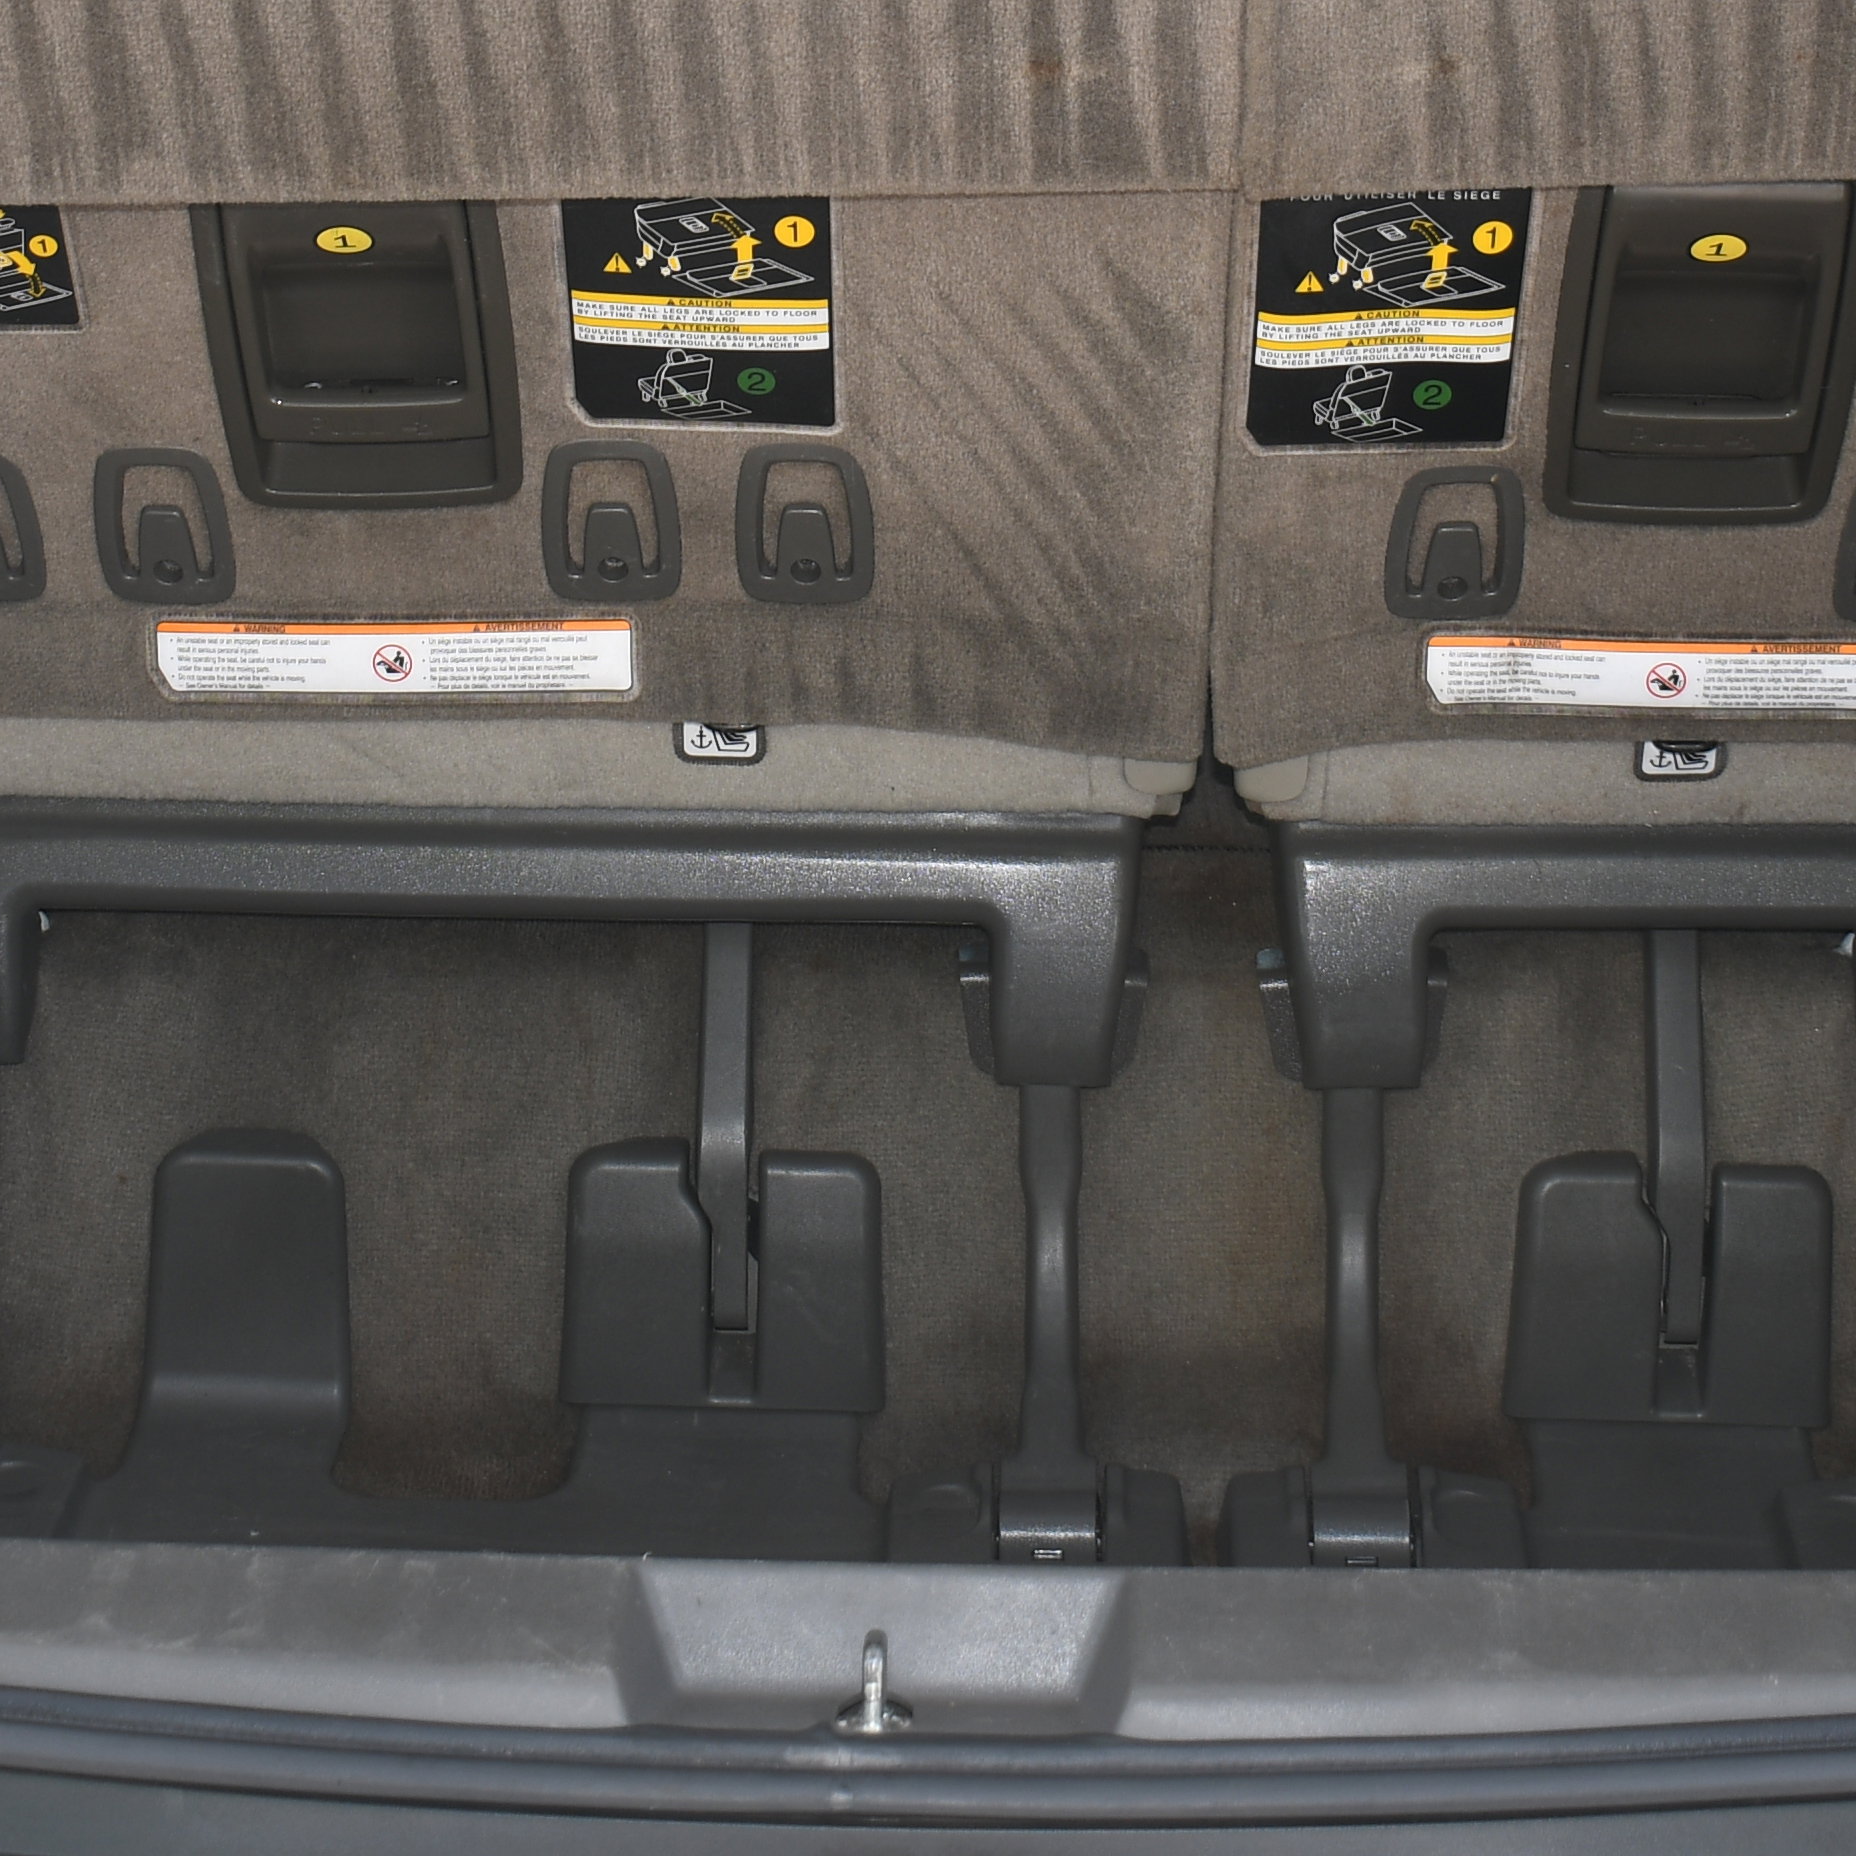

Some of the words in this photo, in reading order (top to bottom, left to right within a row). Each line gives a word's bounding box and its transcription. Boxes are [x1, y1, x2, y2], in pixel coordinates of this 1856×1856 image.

[1428, 190, 1445, 200] LE
[787, 221, 798, 243] 1
[334, 234, 356, 248] 1
[1486, 227, 1497, 249] 1
[37, 239, 47, 253] 1
[1706, 242, 1727, 257] 1
[577, 302, 605, 310] MAKE
[609, 304, 636, 312] SURE
[679, 298, 732, 308] CAUTION
[594, 310, 633, 318] LIFTING
[1367, 309, 1420, 319] CAUTION
[673, 324, 740, 333] ATTENTION
[1262, 324, 1290, 333] MAKE
[1469, 320, 1504, 328] FLOOR
[1279, 332, 1319, 340] LIFTING
[1348, 328, 1372, 336] SEAT
[1377, 326, 1421, 334] UPWARD
[1357, 336, 1424, 345] ATTENTION
[746, 371, 766, 391] 2
[1422, 384, 1442, 406] 2
[244, 624, 286, 633] WARNING
[1519, 639, 1562, 648] WARNING
[1762, 645, 1841, 654] AVERTISSEMENT
